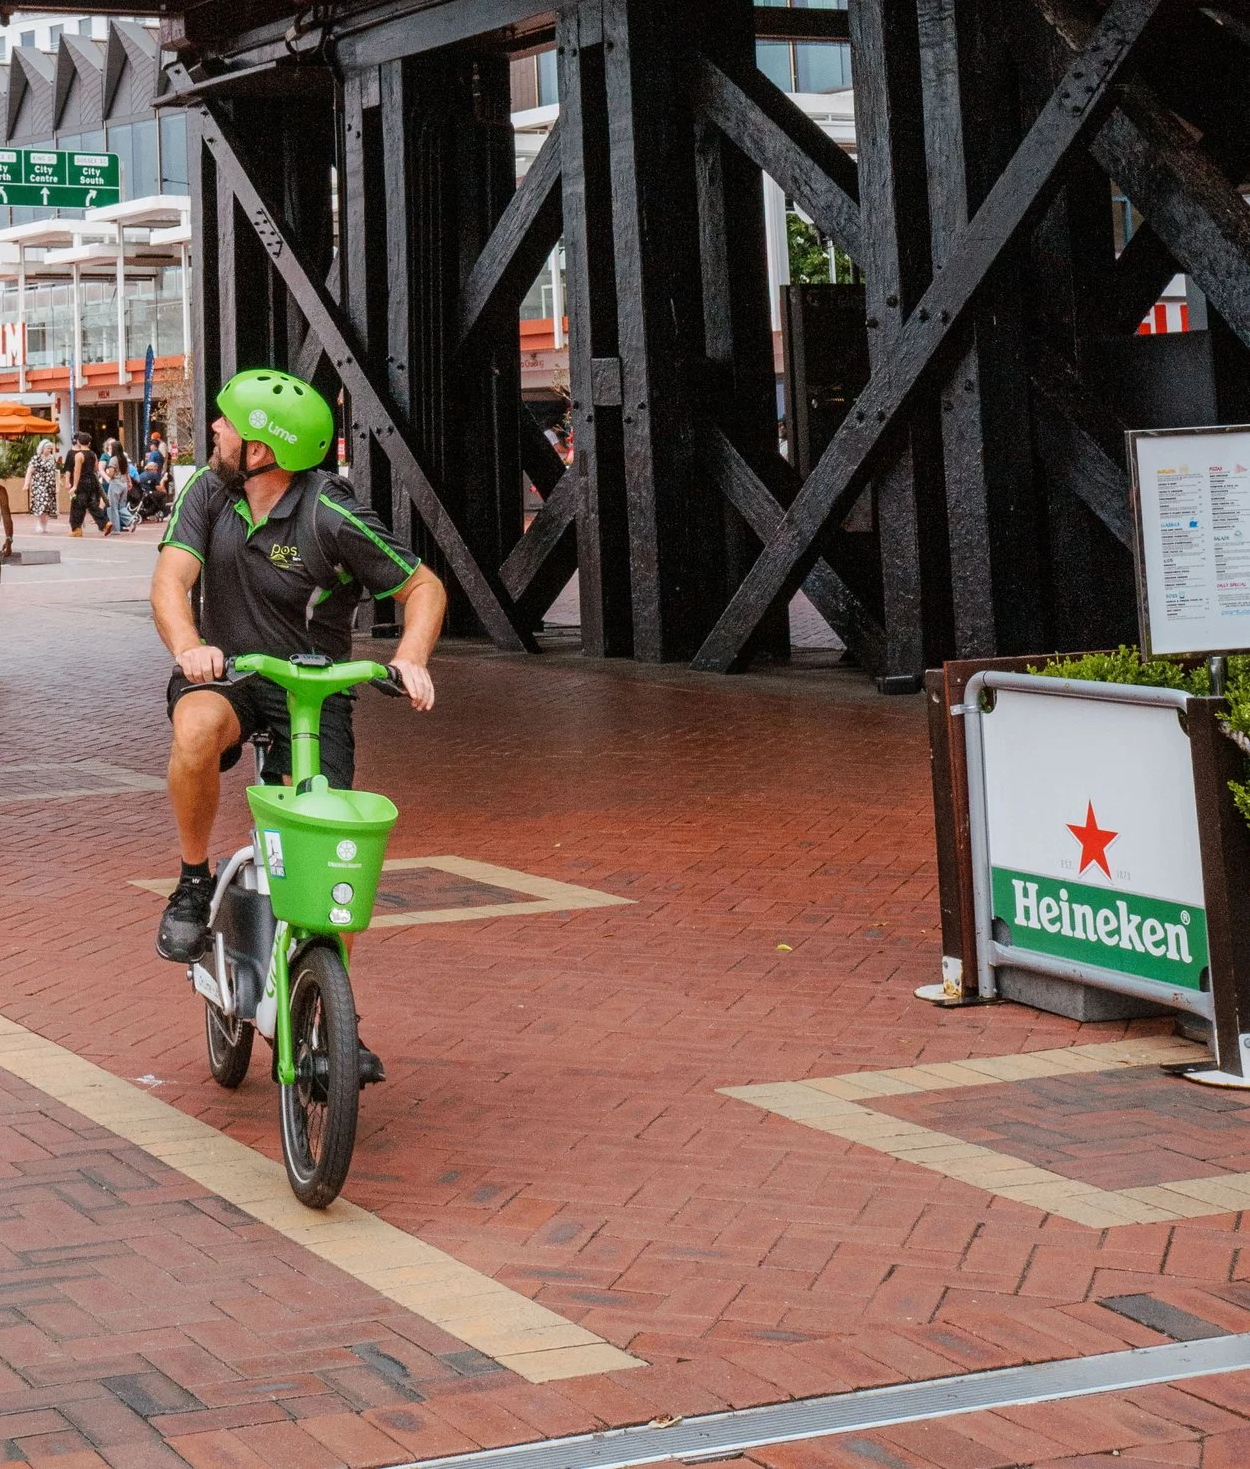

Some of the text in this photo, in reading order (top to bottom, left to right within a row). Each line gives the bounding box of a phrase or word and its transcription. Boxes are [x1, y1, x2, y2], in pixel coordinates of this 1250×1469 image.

[34, 165, 53, 175] City
[82, 167, 101, 177] City
[29, 174, 58, 183] Centre
[79, 176, 104, 185] South
[268, 421, 298, 445] Lime
[1012, 879, 1193, 964] Heineken
